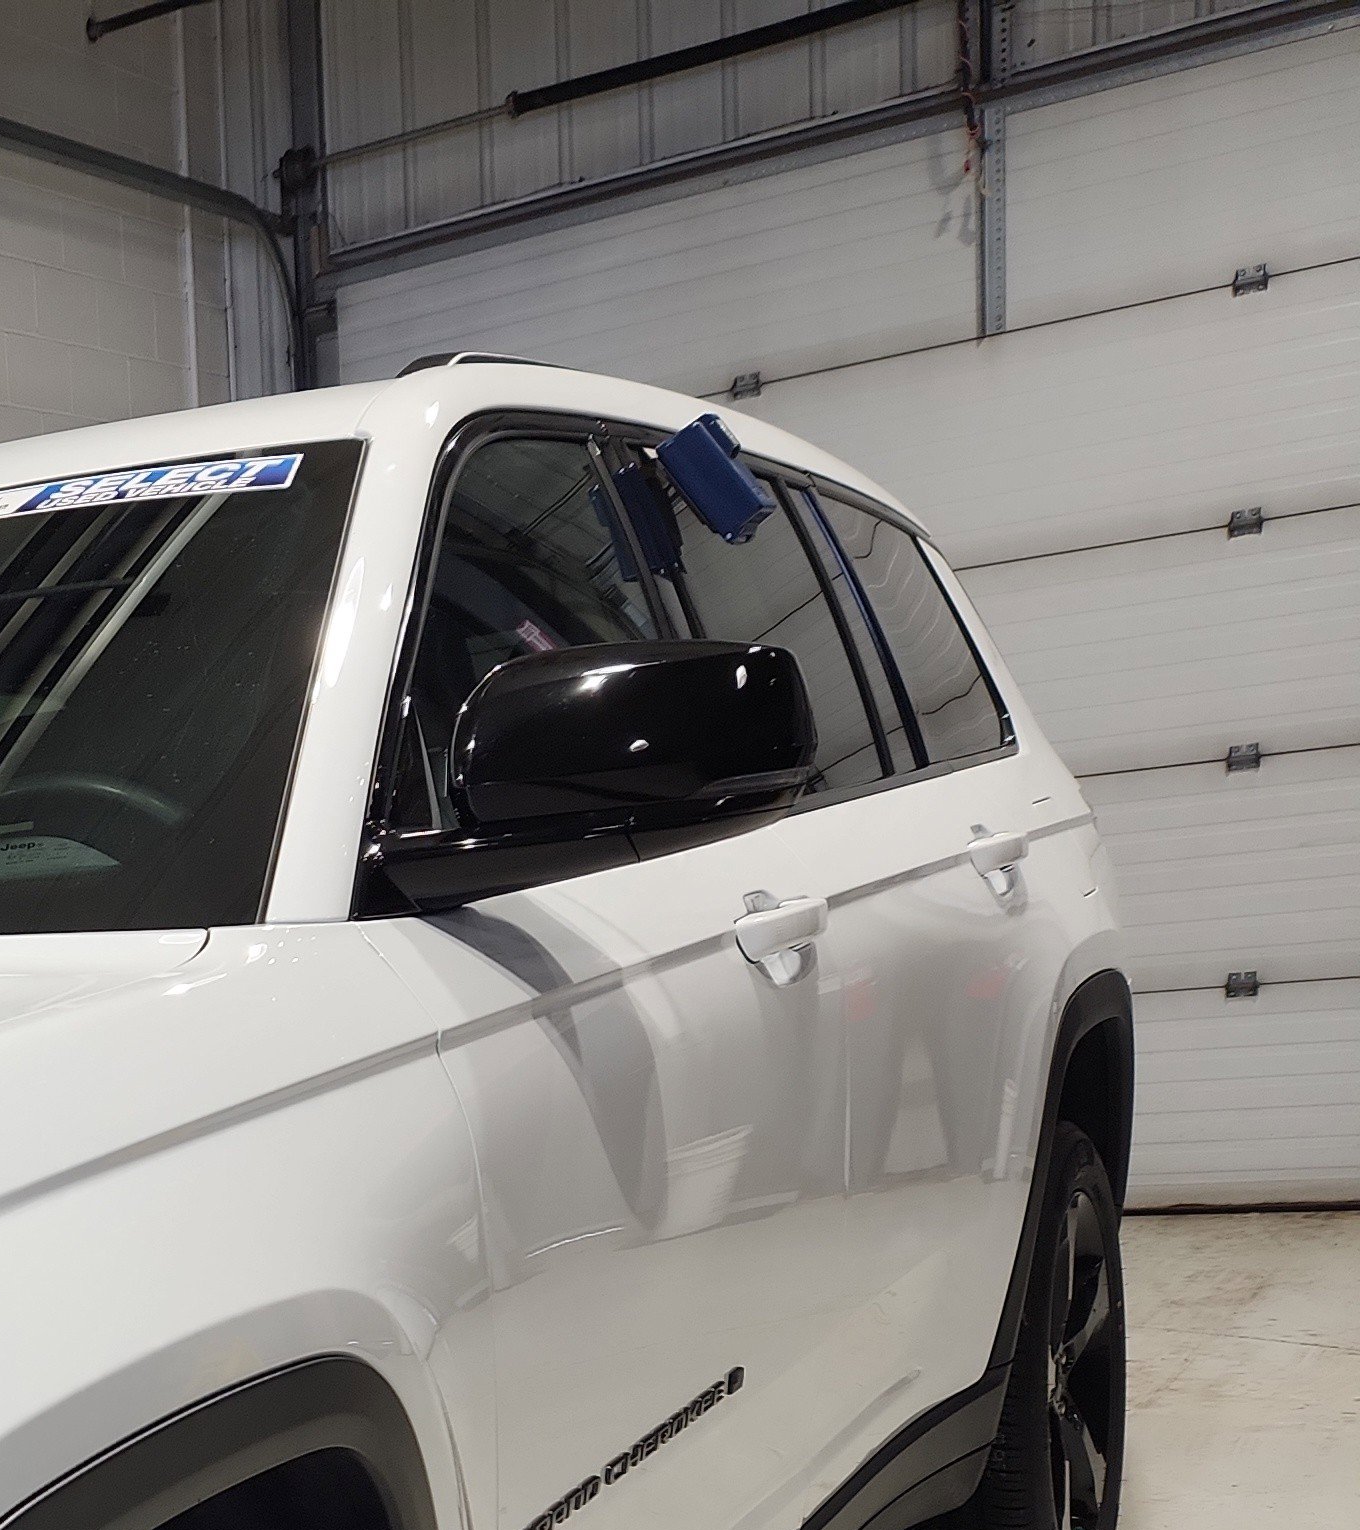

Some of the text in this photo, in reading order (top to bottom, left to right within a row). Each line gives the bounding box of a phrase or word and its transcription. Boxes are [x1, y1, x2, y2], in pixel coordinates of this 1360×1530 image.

[36, 477, 258, 509] USED VEHICLE
[50, 457, 284, 498] SELECT
[0, 842, 36, 852] Jeep
[602, 1381, 726, 1485] CHEROKEE
